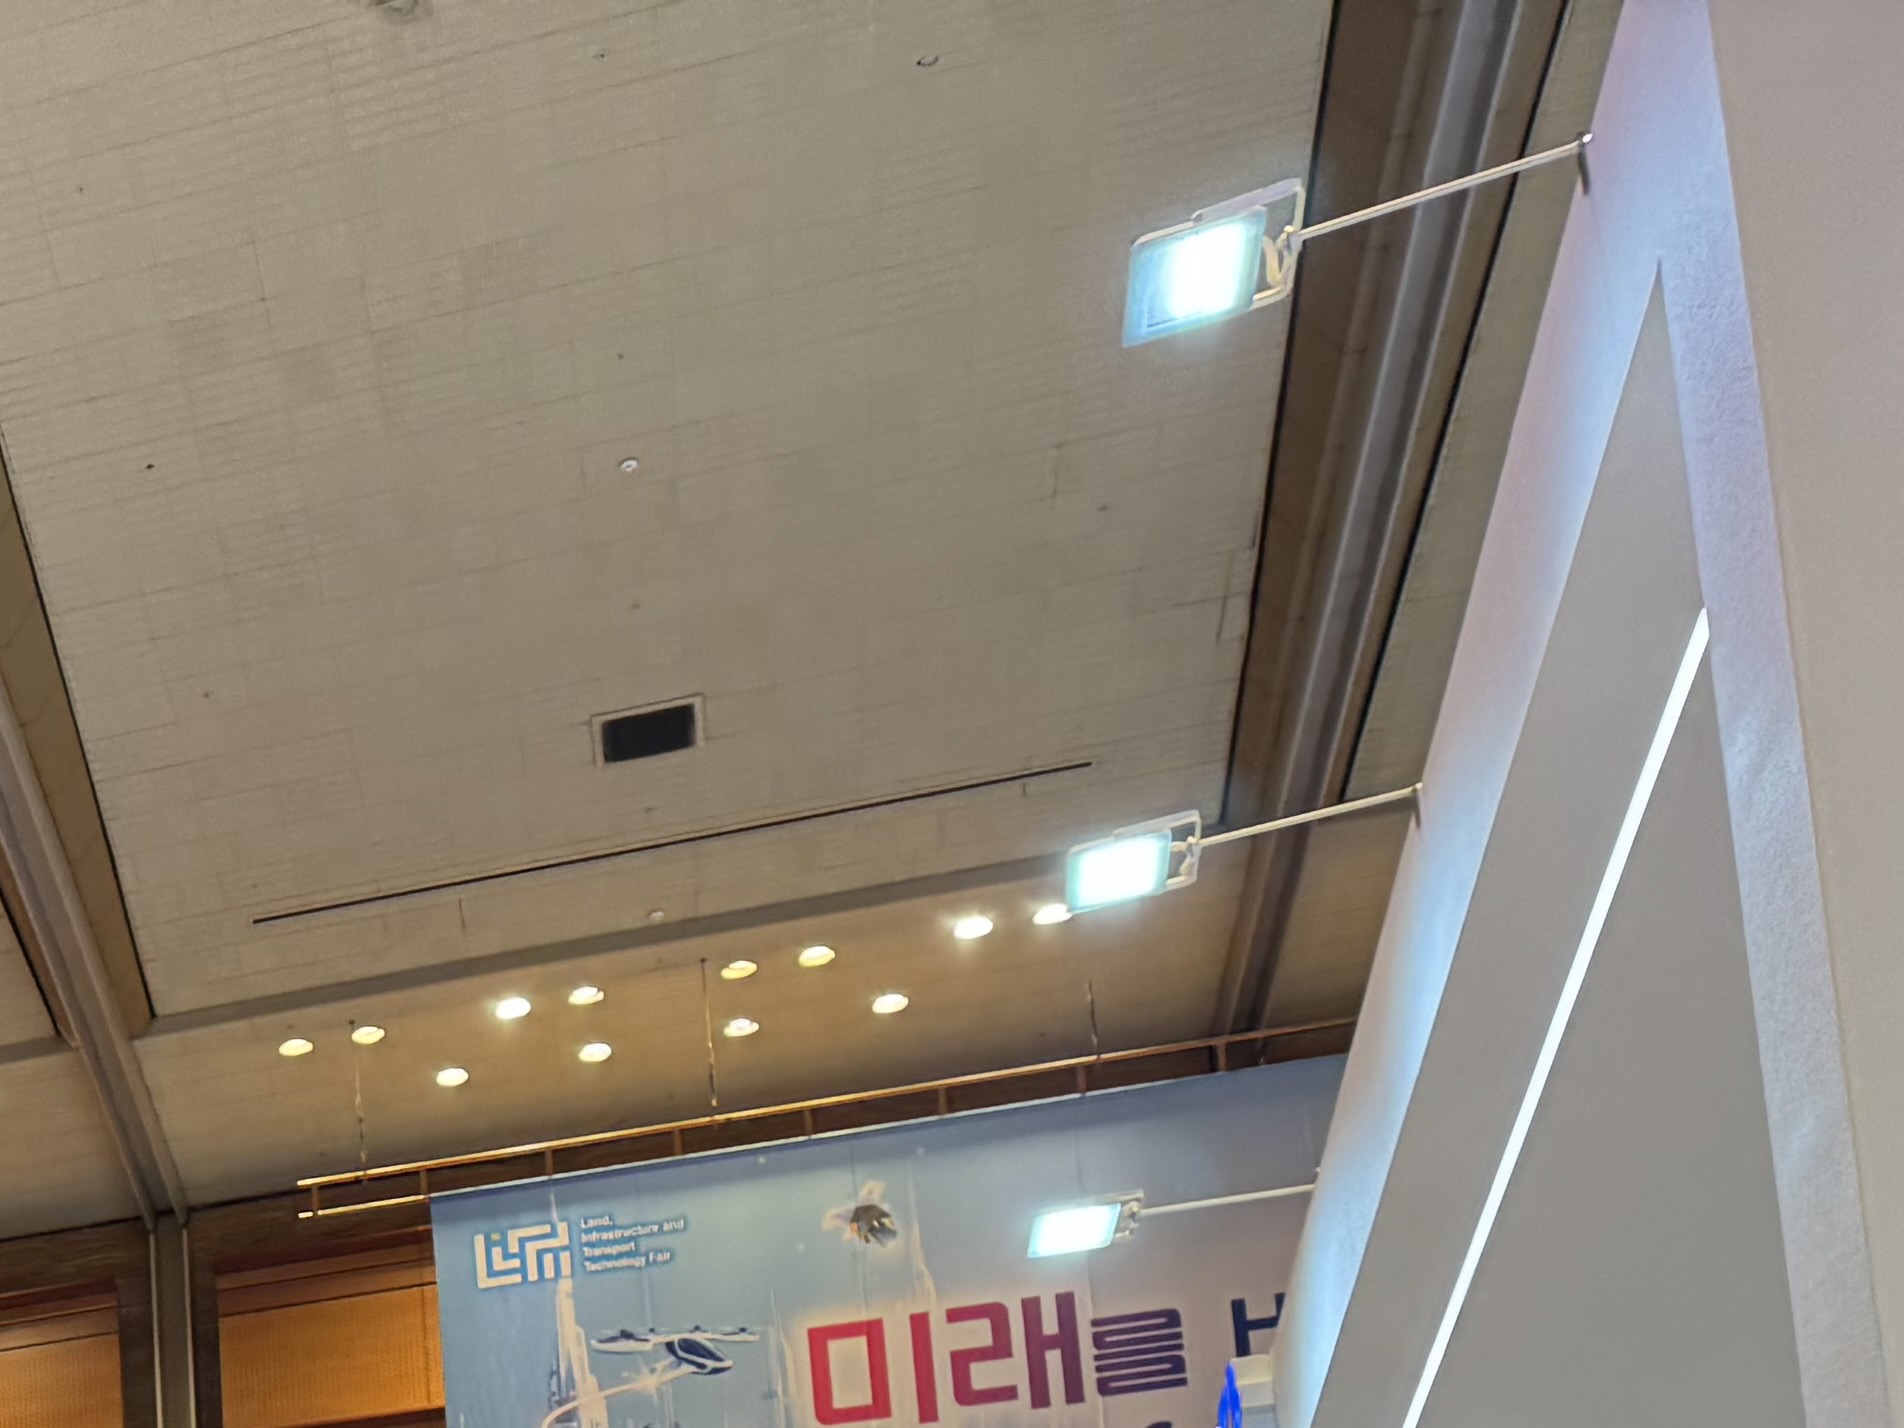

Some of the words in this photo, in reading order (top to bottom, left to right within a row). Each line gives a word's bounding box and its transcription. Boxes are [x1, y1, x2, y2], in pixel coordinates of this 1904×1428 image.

[663, 1218, 685, 1232] and
[583, 1242, 636, 1258] Transport
[585, 1253, 646, 1273] Technology
[649, 1250, 671, 1263] Fair
[806, 1290, 1188, 1427] 미래를
